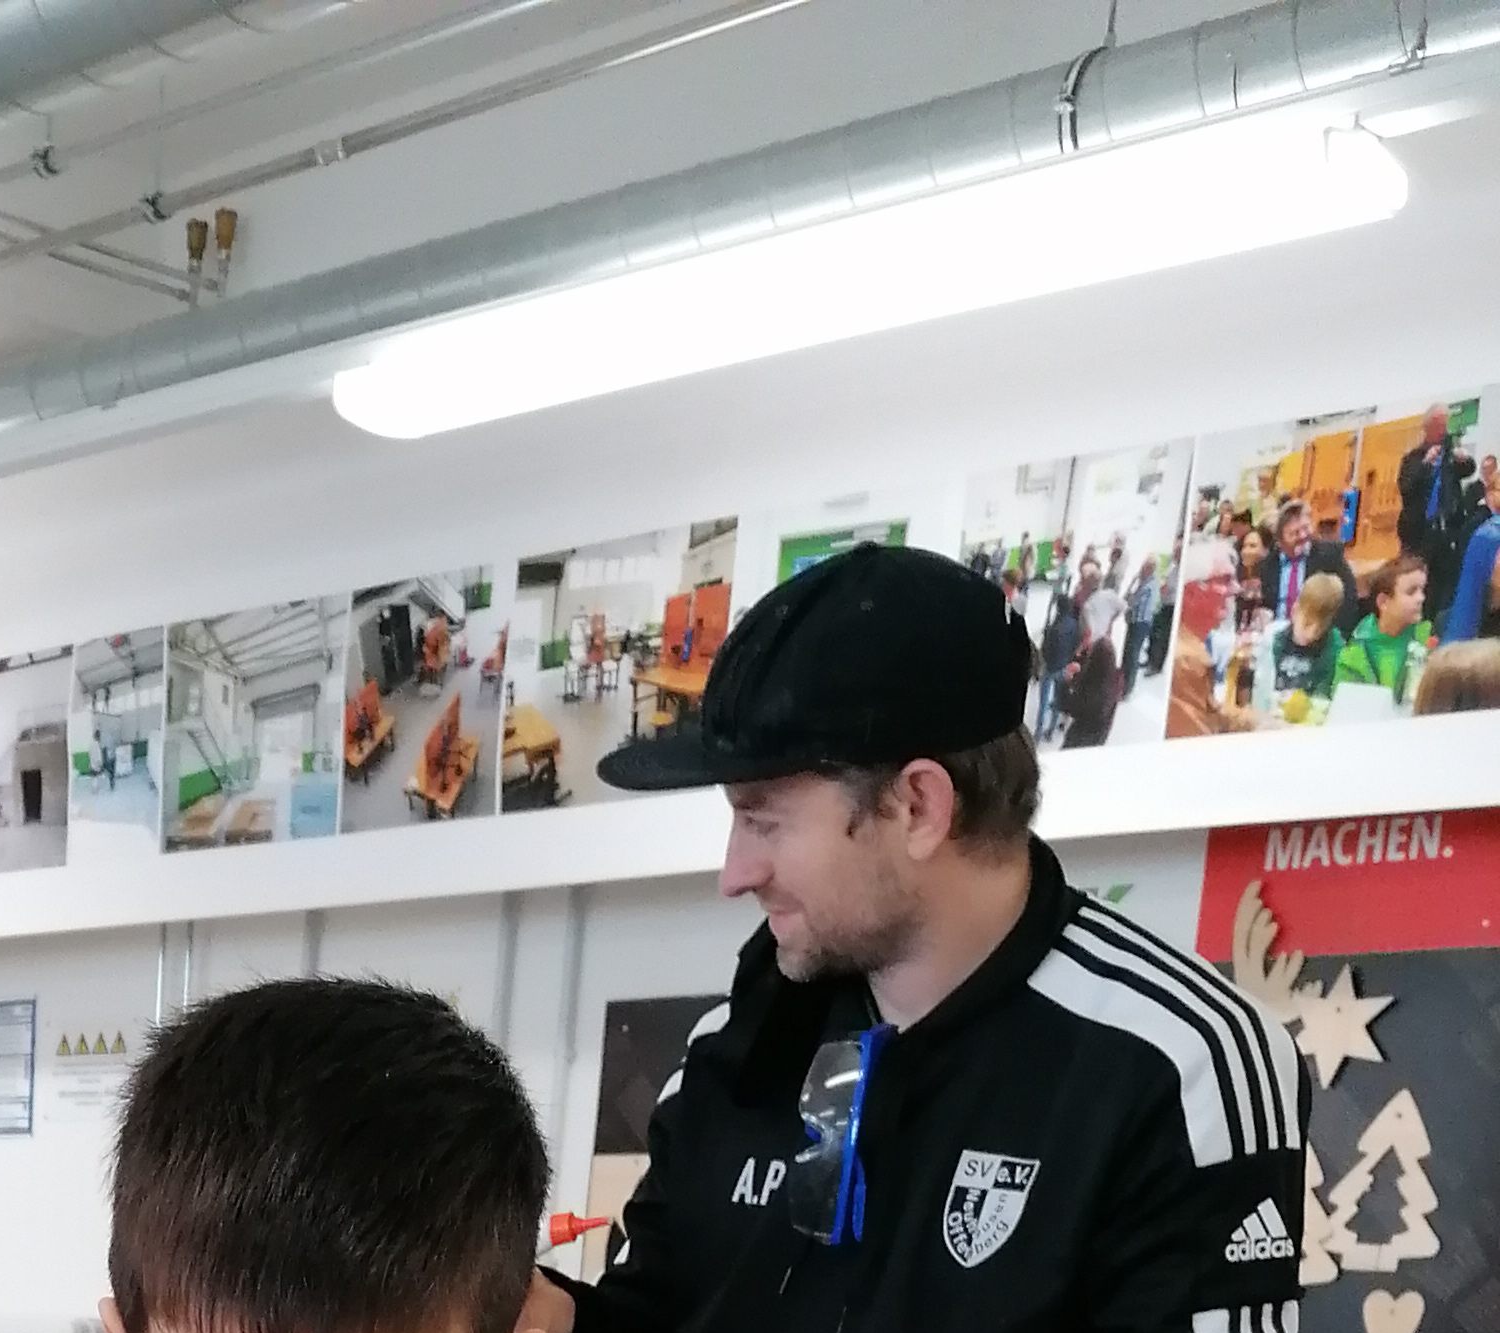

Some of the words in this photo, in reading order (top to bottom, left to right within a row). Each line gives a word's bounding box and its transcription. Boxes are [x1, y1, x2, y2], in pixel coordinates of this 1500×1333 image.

[1264, 815, 1453, 872] MACHEN.
[964, 1160, 994, 1178] SV
[1224, 1235, 1294, 1263] adidas
